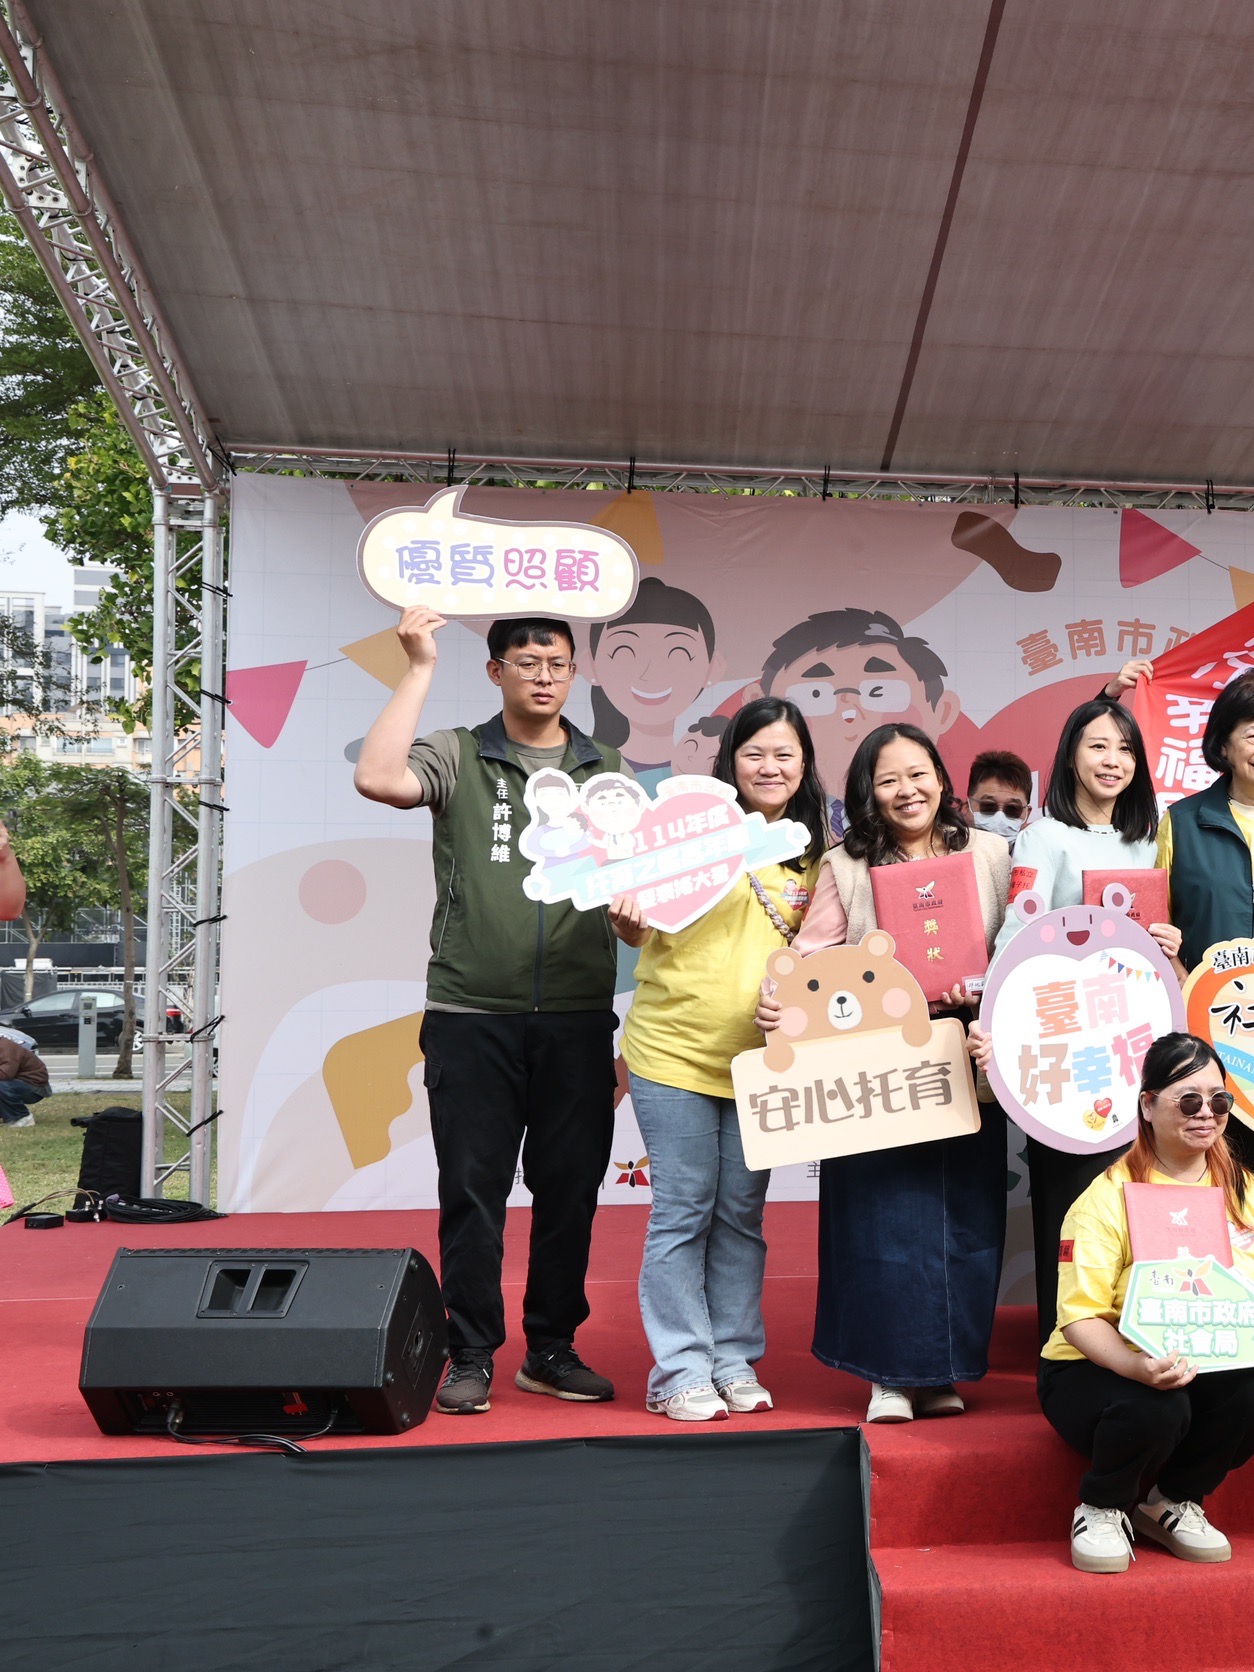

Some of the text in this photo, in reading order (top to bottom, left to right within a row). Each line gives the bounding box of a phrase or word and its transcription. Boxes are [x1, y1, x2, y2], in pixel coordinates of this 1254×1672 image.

[395, 540, 600, 592] 優質照顧
[490, 778, 512, 863] 主任 許博維
[634, 804, 731, 854] 114年度
[1032, 971, 1130, 1040] 臺南
[749, 1059, 953, 1134] 安心托育
[1018, 1021, 1154, 1106] 好幸福
[1163, 1328, 1239, 1356] 社會局
